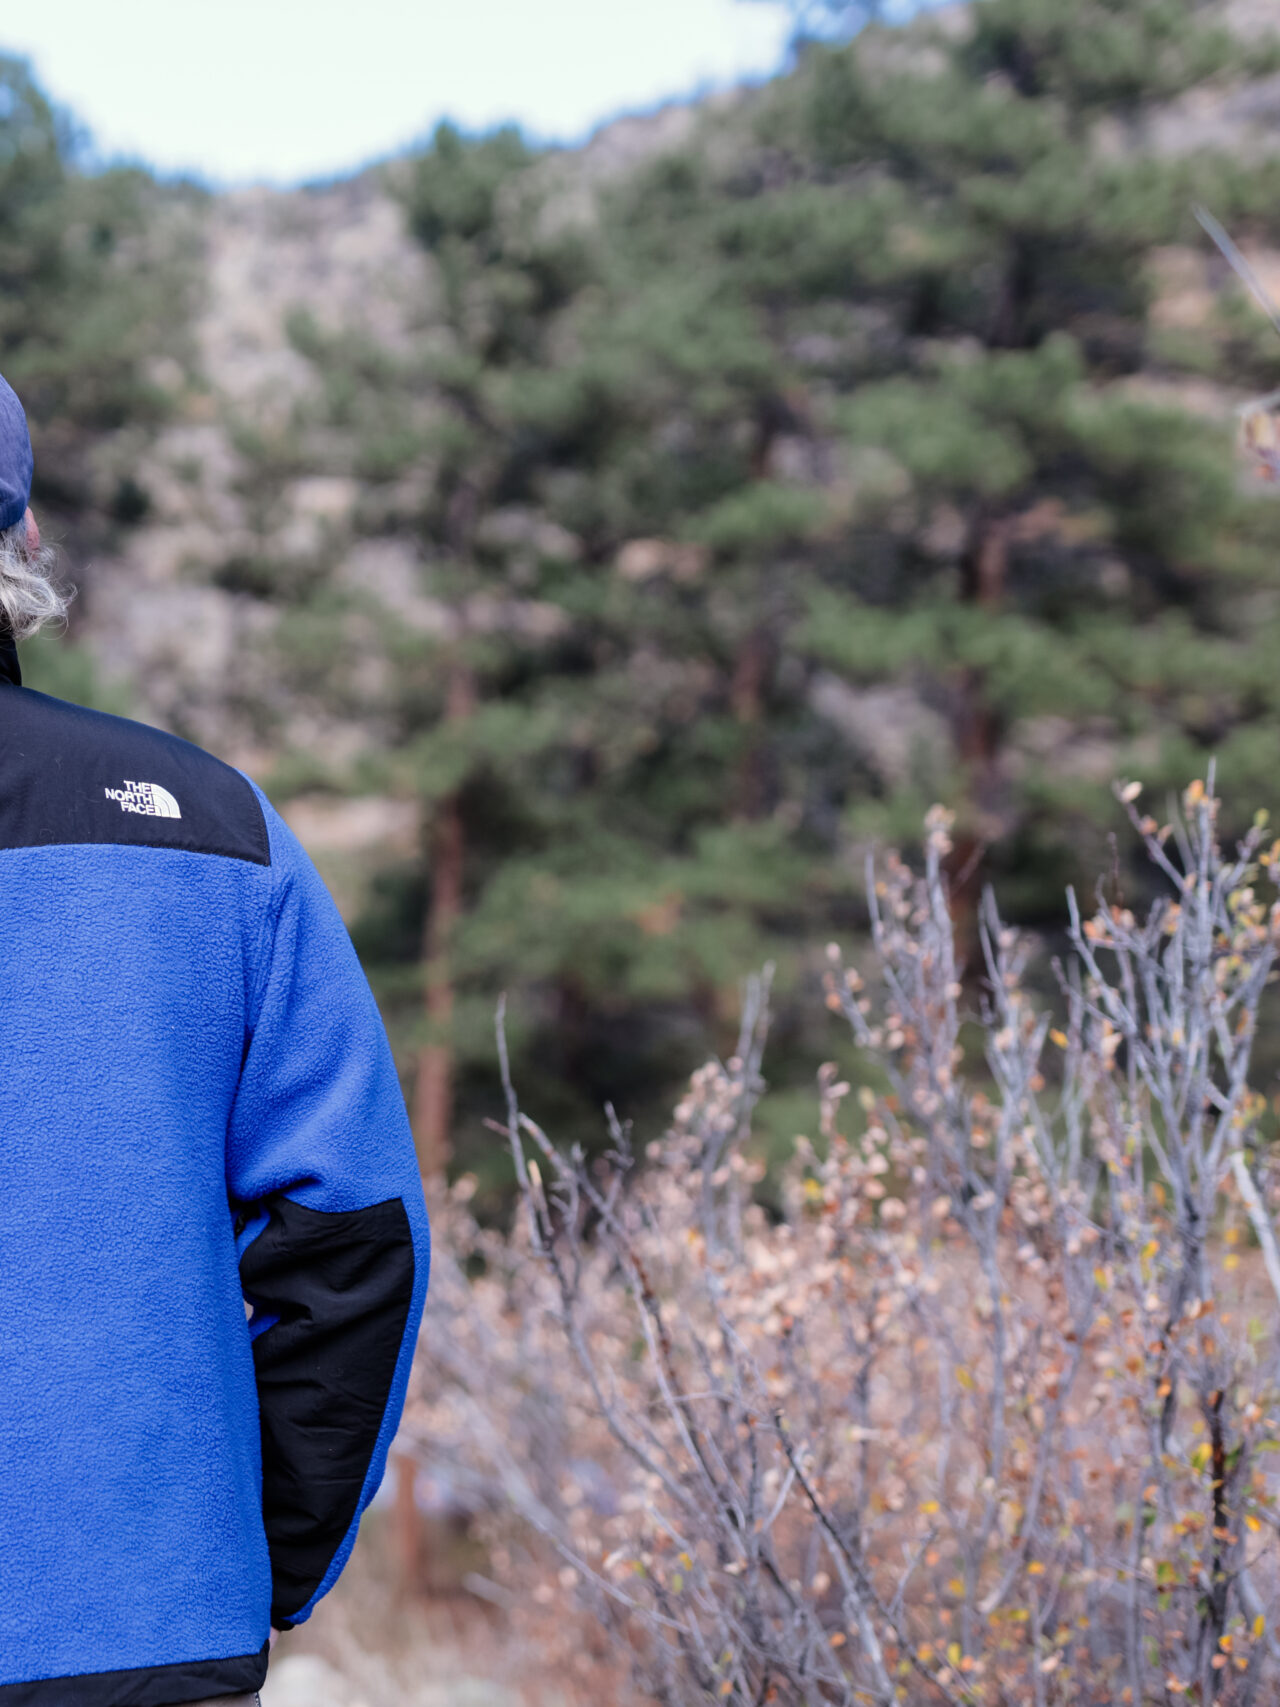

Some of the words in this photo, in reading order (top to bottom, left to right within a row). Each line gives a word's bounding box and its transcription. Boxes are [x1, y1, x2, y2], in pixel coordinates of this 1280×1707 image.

[123, 780, 152, 794] THE
[104, 787, 153, 805] NORTH
[120, 801, 156, 815] FACE
